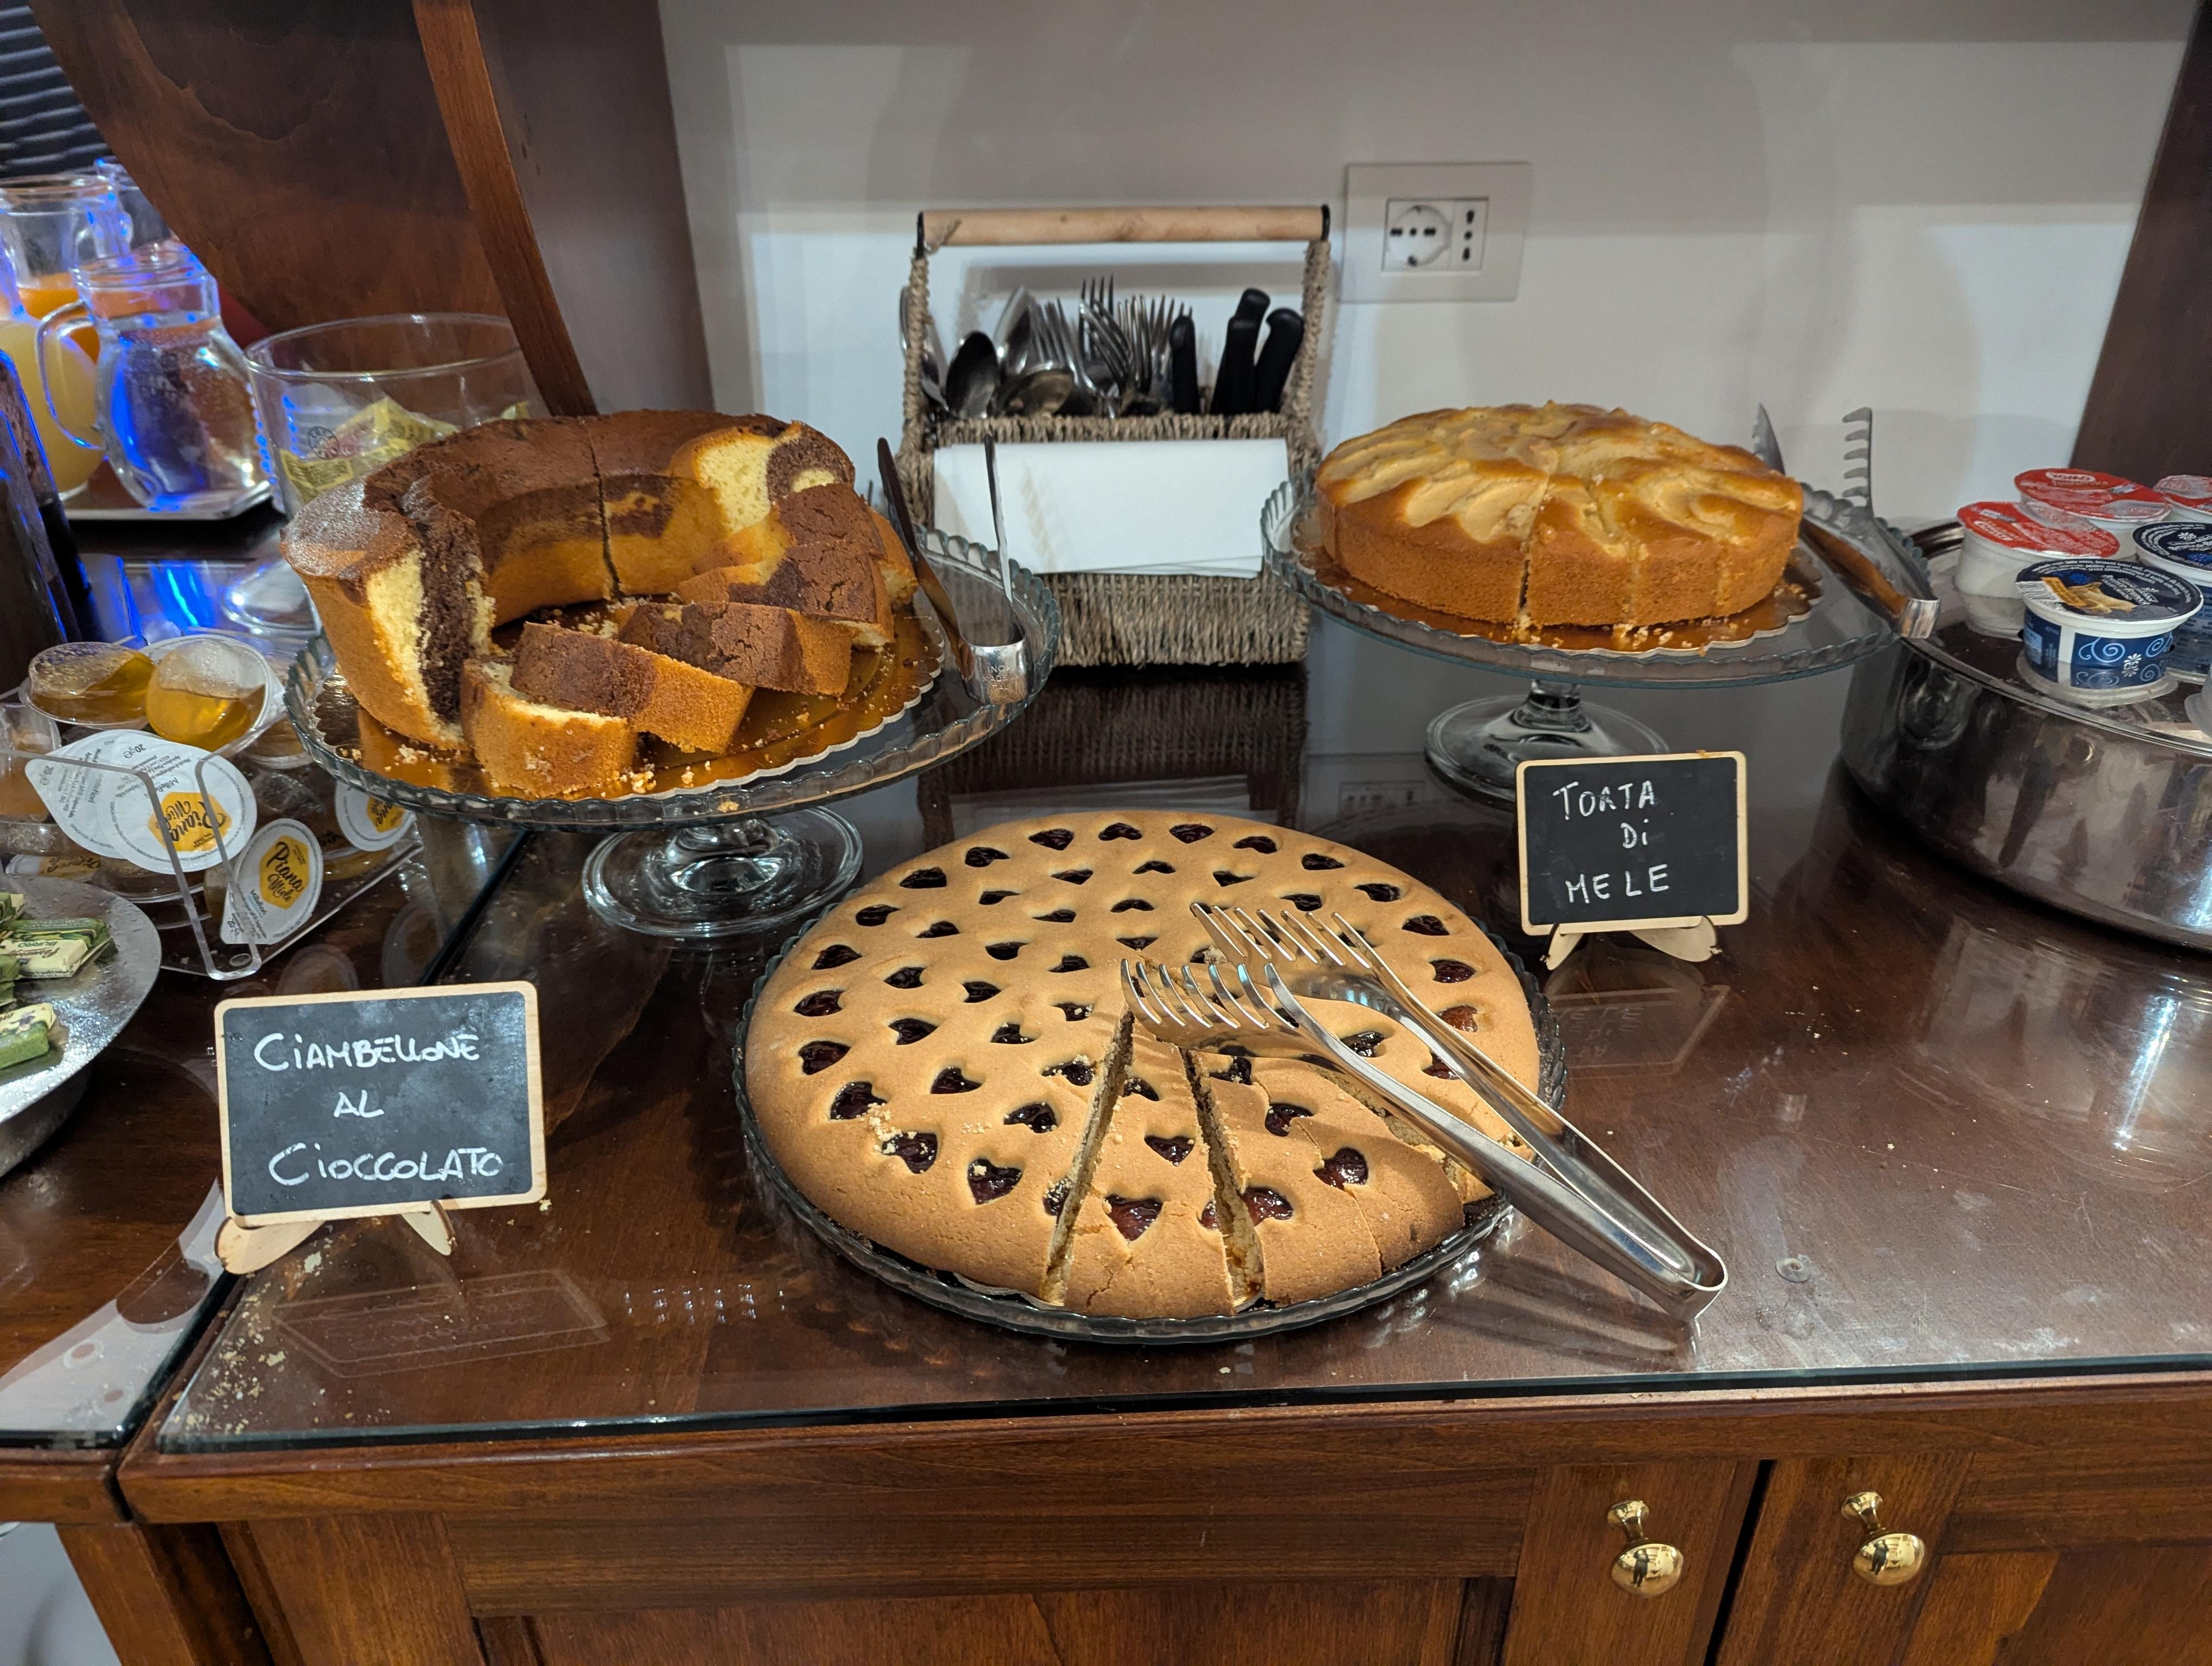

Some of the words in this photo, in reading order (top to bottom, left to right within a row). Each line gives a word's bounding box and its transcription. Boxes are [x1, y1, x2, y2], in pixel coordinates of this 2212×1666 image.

[987, 663, 1011, 673] INOX
[267, 841, 304, 892] Piana
[267, 874, 293, 902] Miele
[1565, 864, 1669, 904] MELE
[333, 1090, 384, 1118] AL
